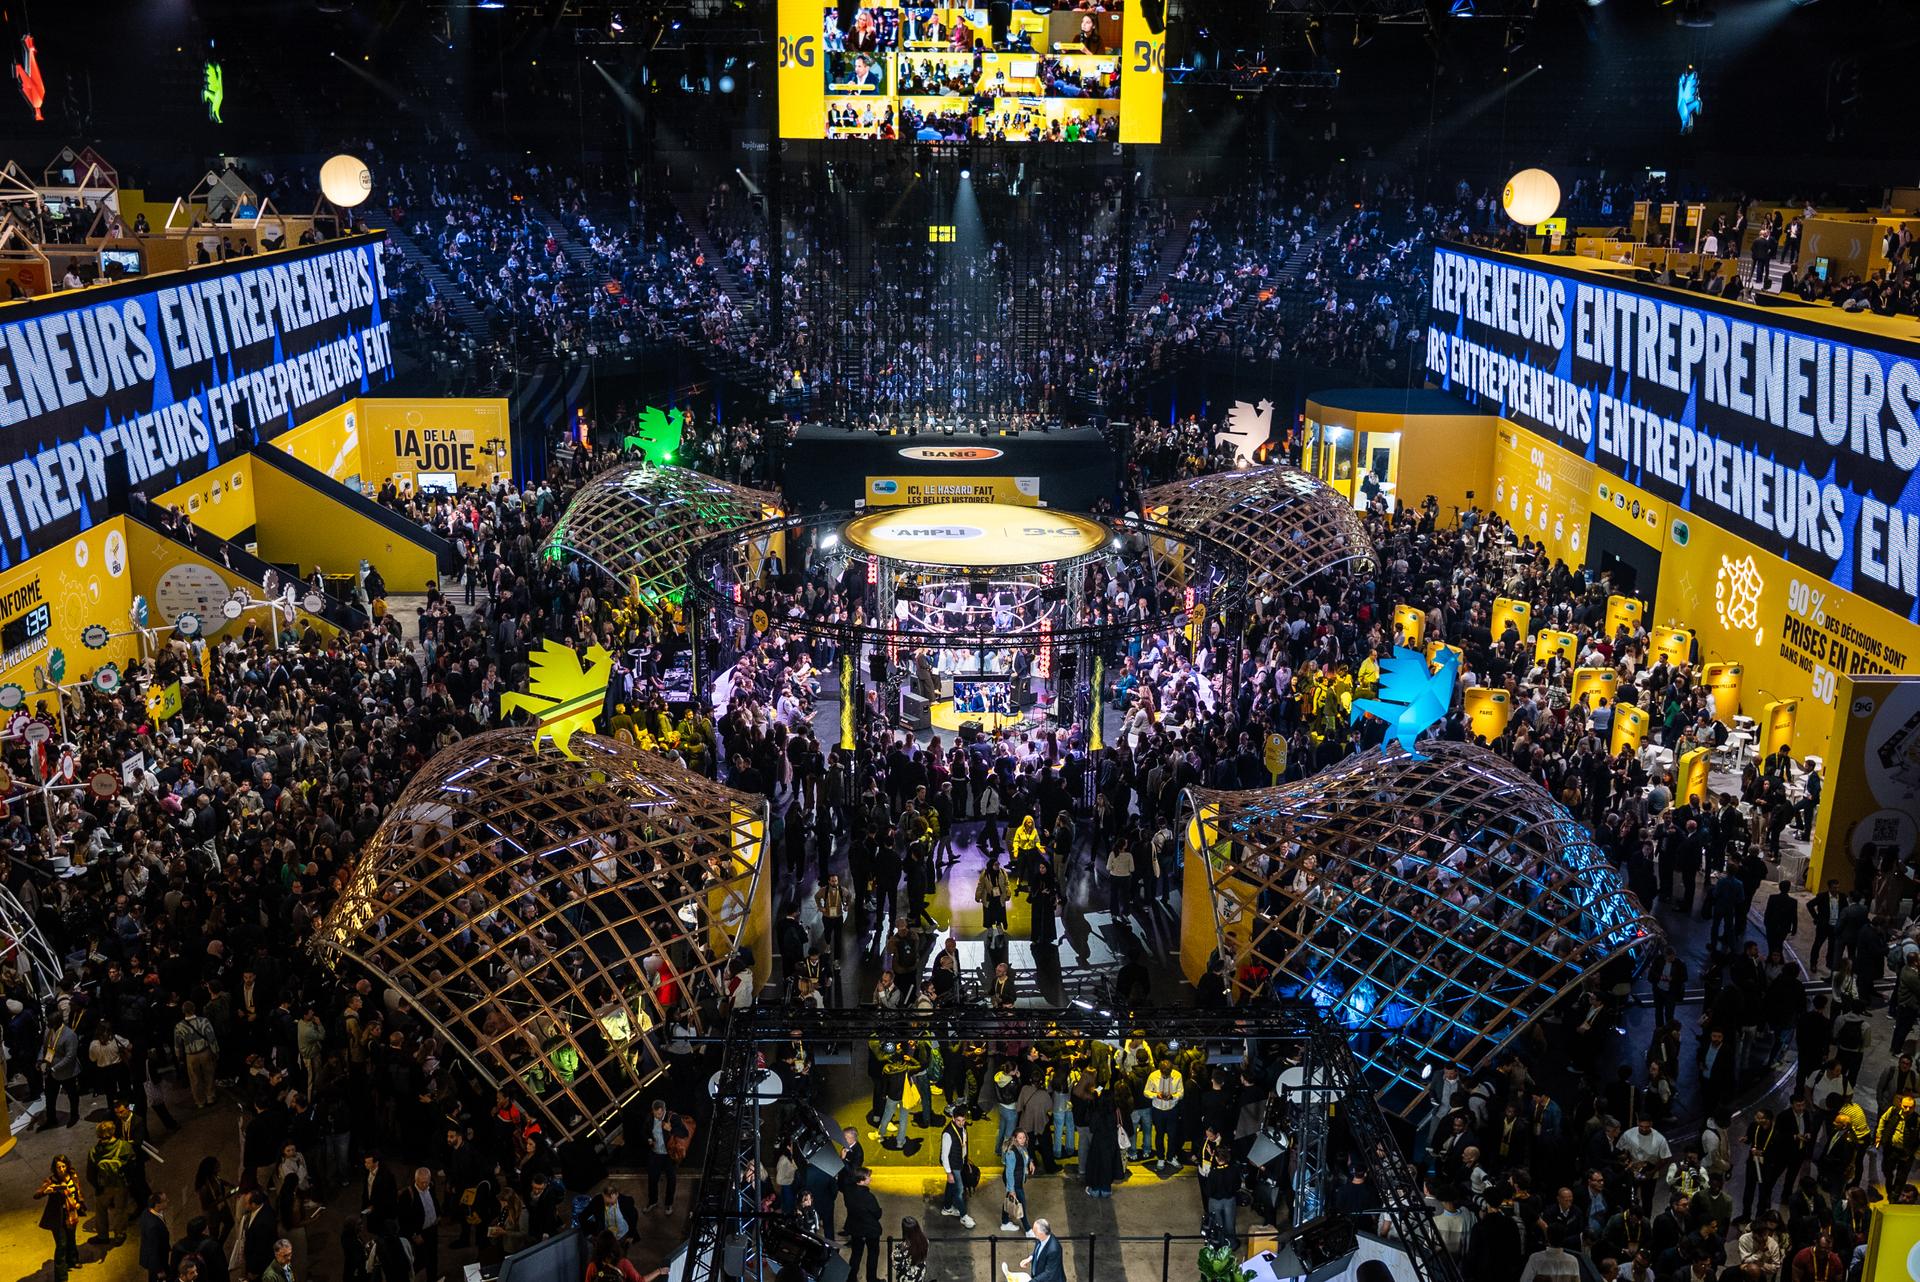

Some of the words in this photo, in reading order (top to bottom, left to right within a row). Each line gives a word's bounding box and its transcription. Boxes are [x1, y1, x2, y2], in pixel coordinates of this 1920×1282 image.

[157, 247, 374, 369] ENTREPRENEURS
[361, 320, 392, 375] ENT
[1432, 251, 1565, 350] REPRENEURS
[1576, 284, 1920, 471] ENTREPRENEURS
[394, 429, 421, 457] IA
[424, 430, 438, 442] DE
[441, 430, 457, 442] LA
[416, 443, 476, 471] JOIE
[922, 450, 977, 458] BANG
[1451, 335, 1592, 444] ENTREPRENEURS
[1598, 393, 1845, 561] ENTREPRENEURS
[1860, 497, 1920, 597] EN
[908, 486, 921, 496] ICI,
[924, 485, 936, 495] LE
[937, 485, 972, 495] HASARD
[974, 486, 993, 495] FAIT
[908, 496, 921, 504] LES
[923, 496, 950, 505] BELLES
[0, 573, 42, 620] NFORMÉ
[26, 605, 48, 637] 139
[1783, 613, 1827, 660] PRISES
[1828, 639, 1848, 673] EN
[1788, 579, 1825, 626] 90%
[1824, 615, 1840, 635] DES
[1840, 623, 1882, 658] DÉCISIONS
[1883, 646, 1907, 670] SONT
[1780, 643, 1798, 665] DANS
[1798, 654, 1814, 674] NOS
[1812, 664, 1835, 705] 50
